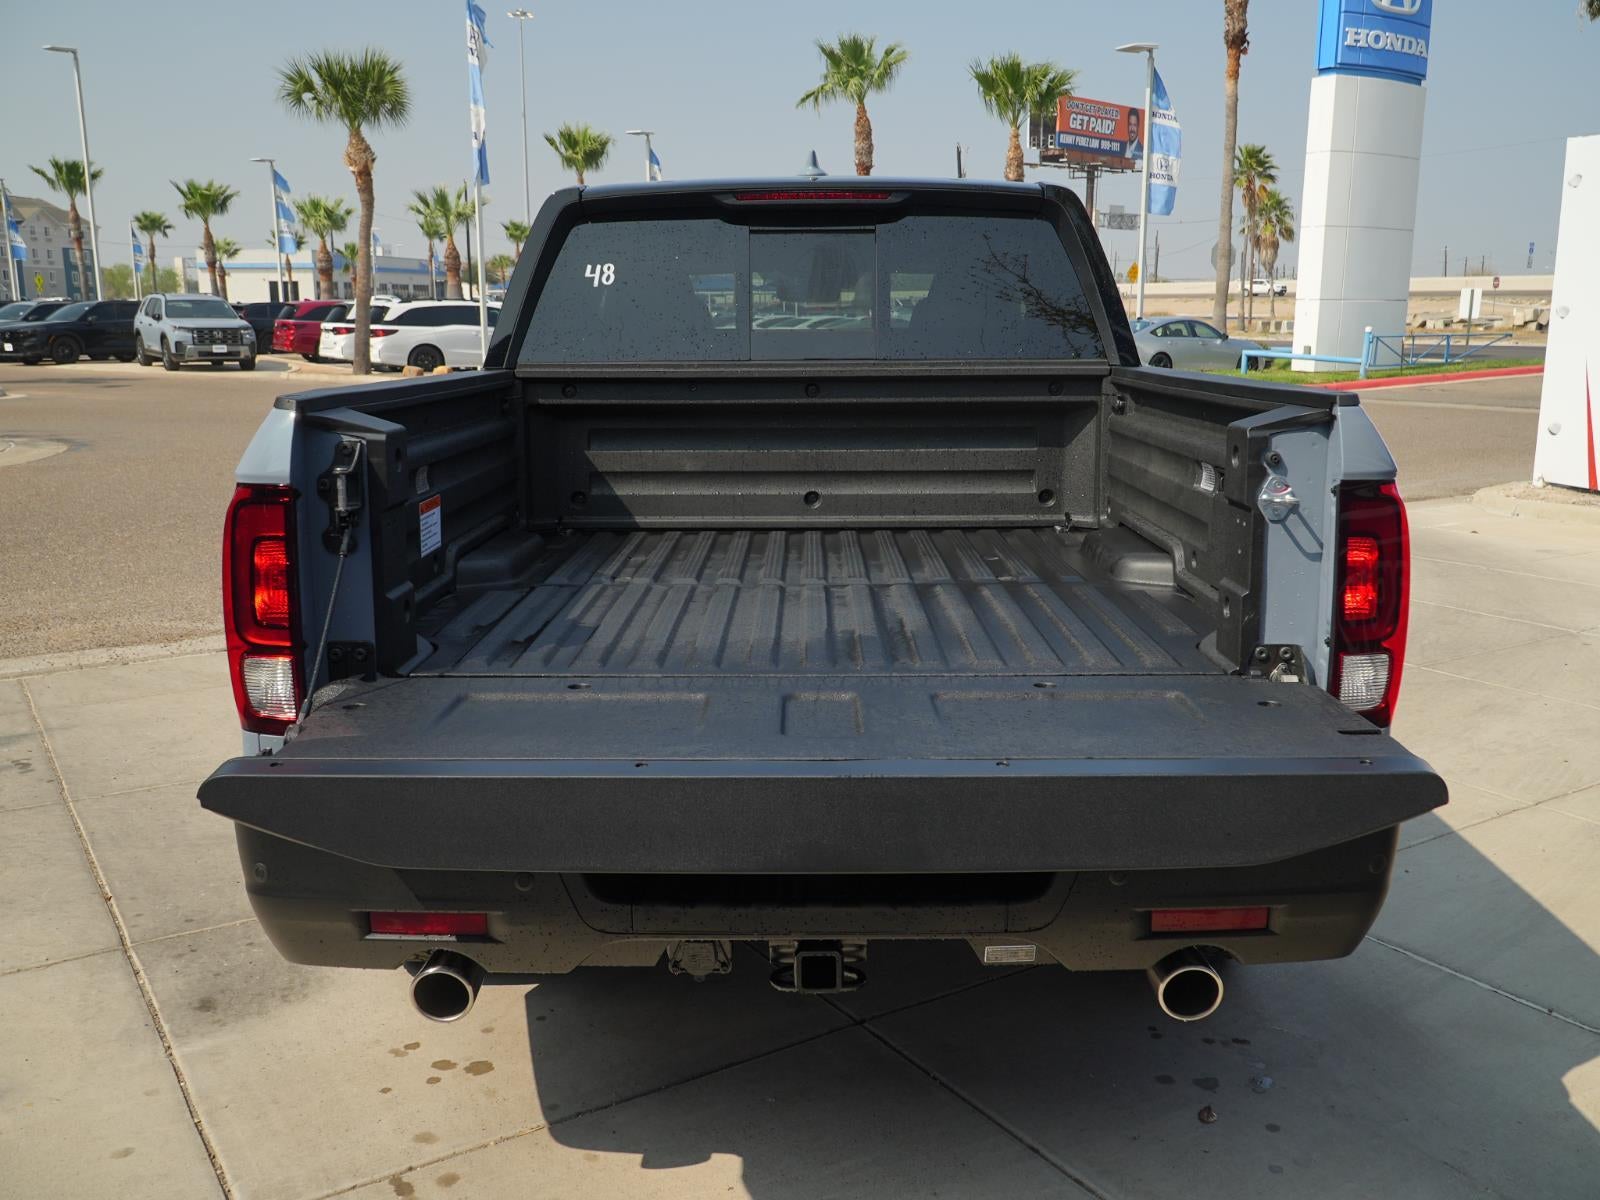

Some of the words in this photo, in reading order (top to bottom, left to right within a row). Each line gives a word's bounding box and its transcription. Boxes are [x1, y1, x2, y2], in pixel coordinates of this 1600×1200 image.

[1344, 27, 1428, 58] HONDA
[1086, 103, 1096, 113] GET
[1097, 104, 1120, 118] PLAYED
[1152, 111, 1178, 123] HONDA
[1069, 113, 1090, 130] GET
[1089, 116, 1116, 135] PAID!
[584, 263, 615, 287] 48
